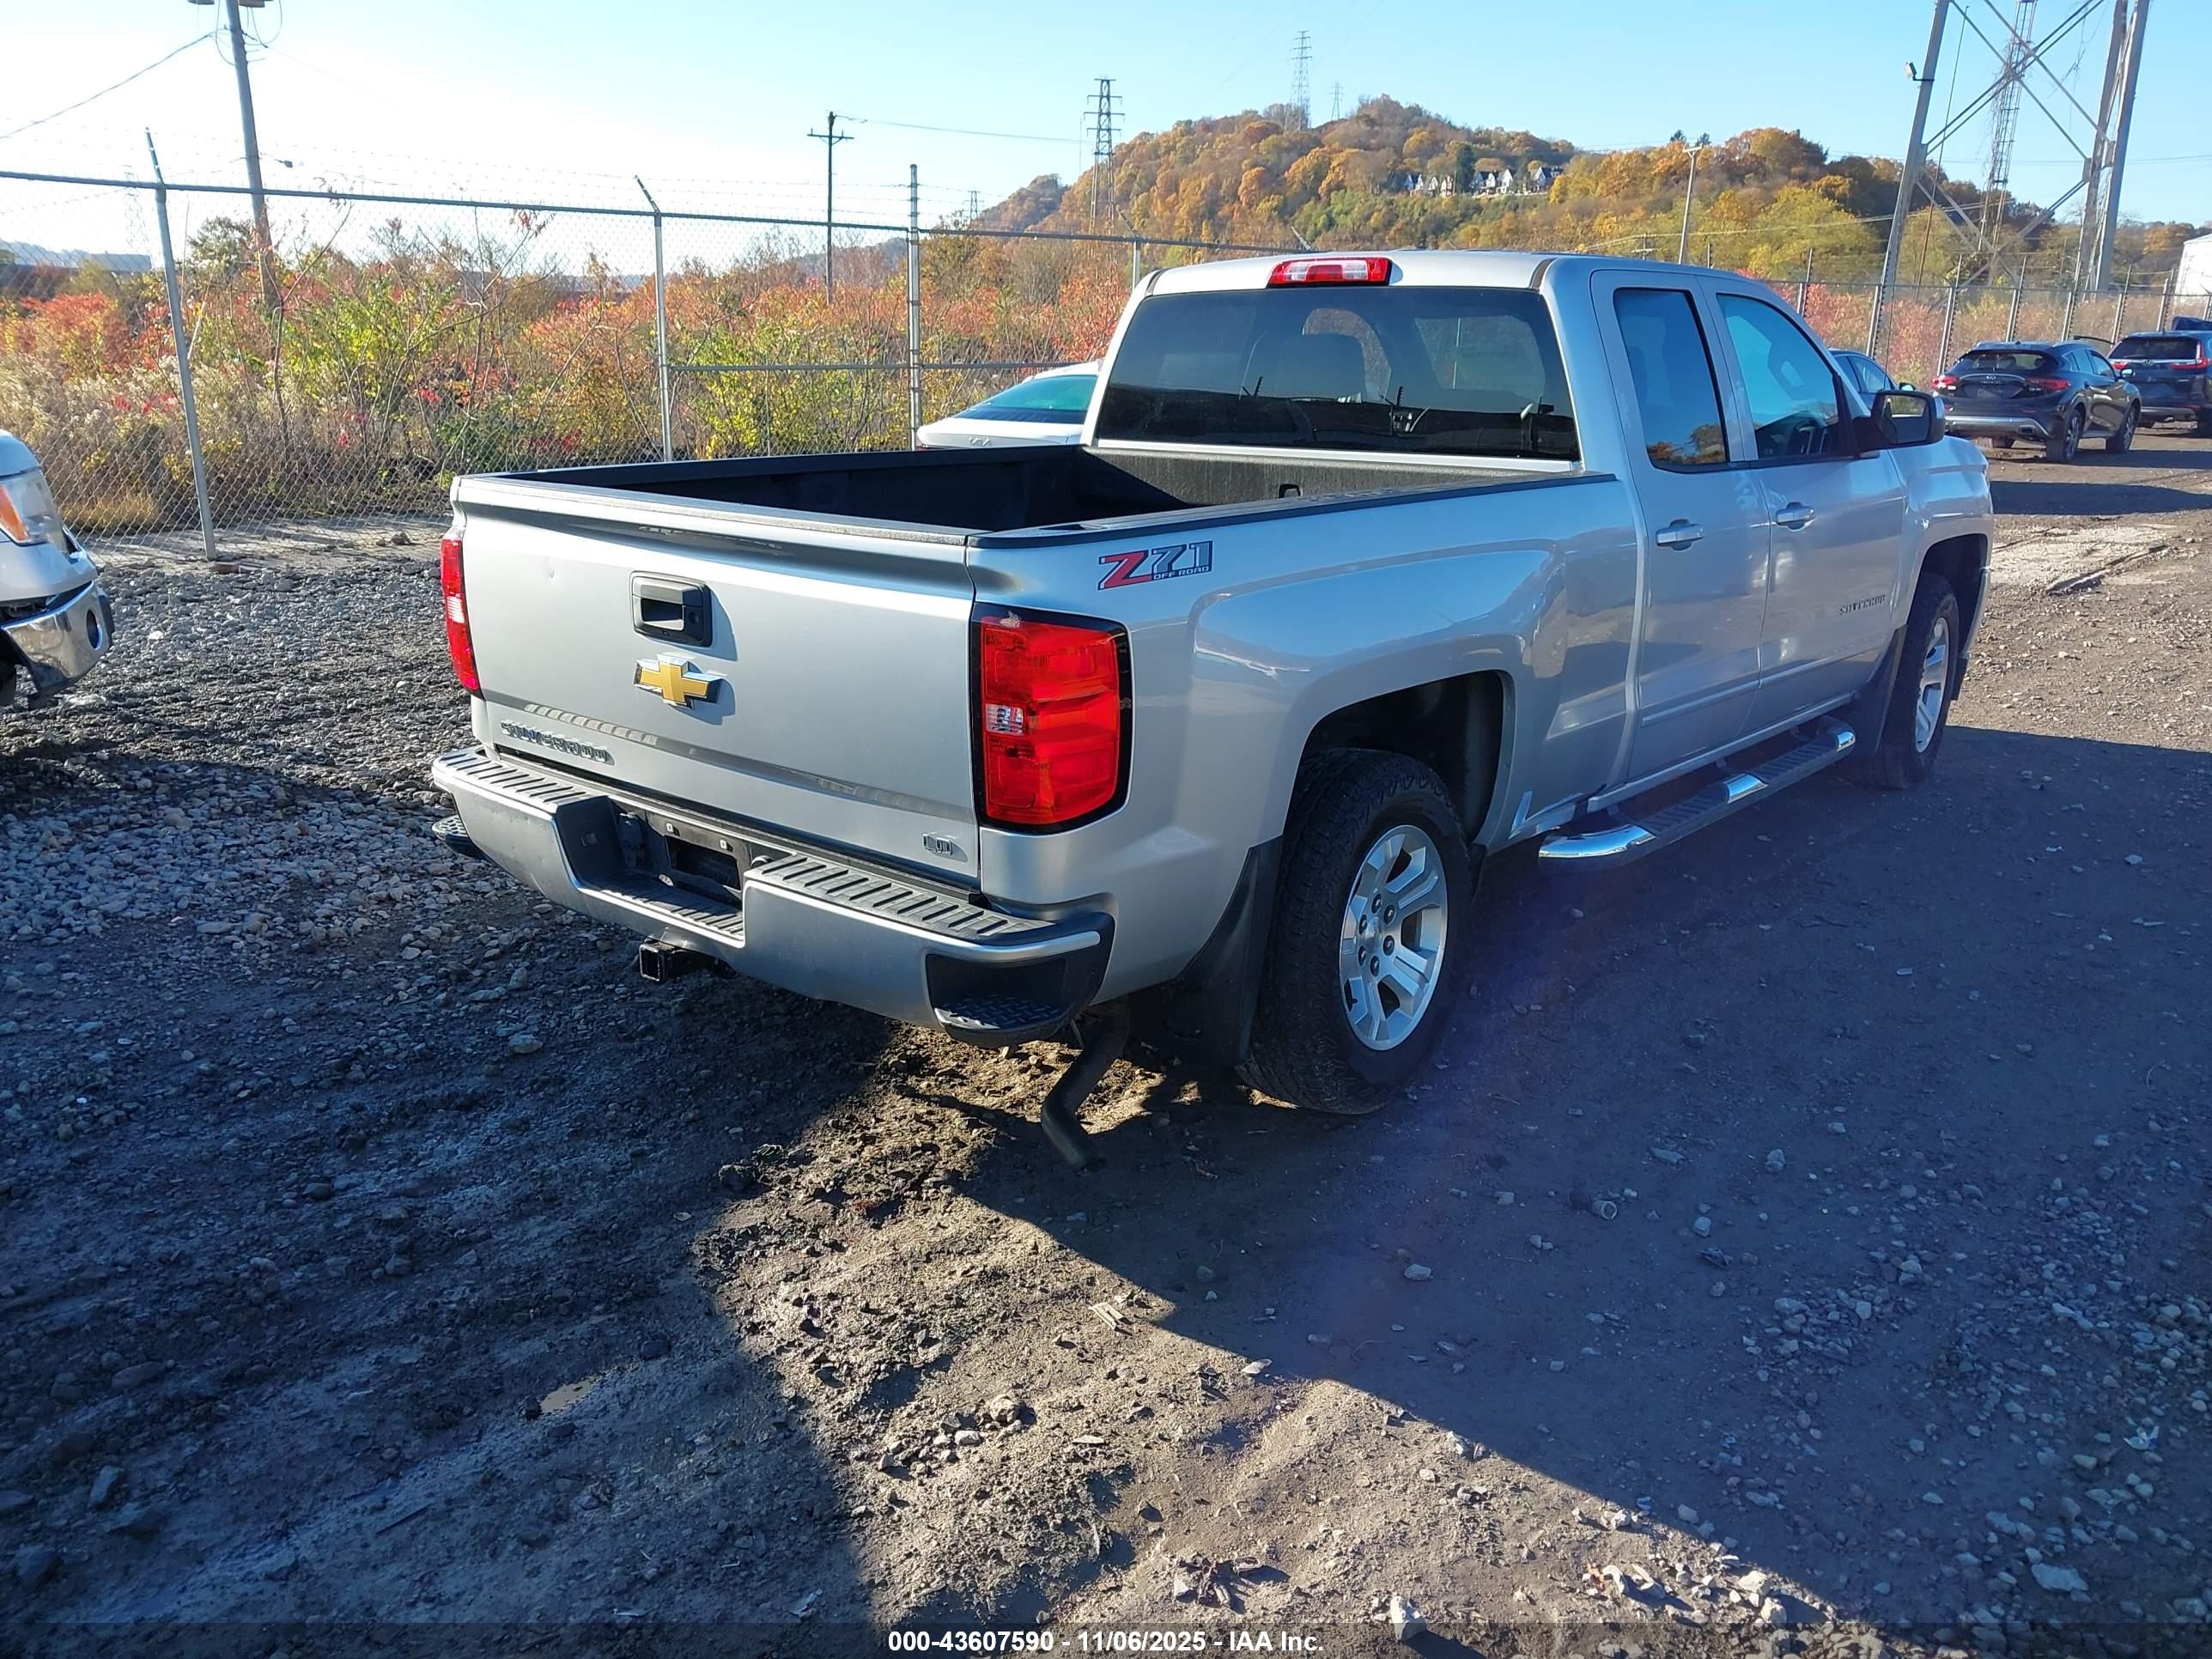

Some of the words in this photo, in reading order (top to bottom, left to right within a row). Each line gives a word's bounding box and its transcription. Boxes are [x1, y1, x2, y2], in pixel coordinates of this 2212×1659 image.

[1097, 540, 1213, 591] Z71
[1153, 572, 1176, 580] OFF
[1178, 566, 1210, 576] ROAD
